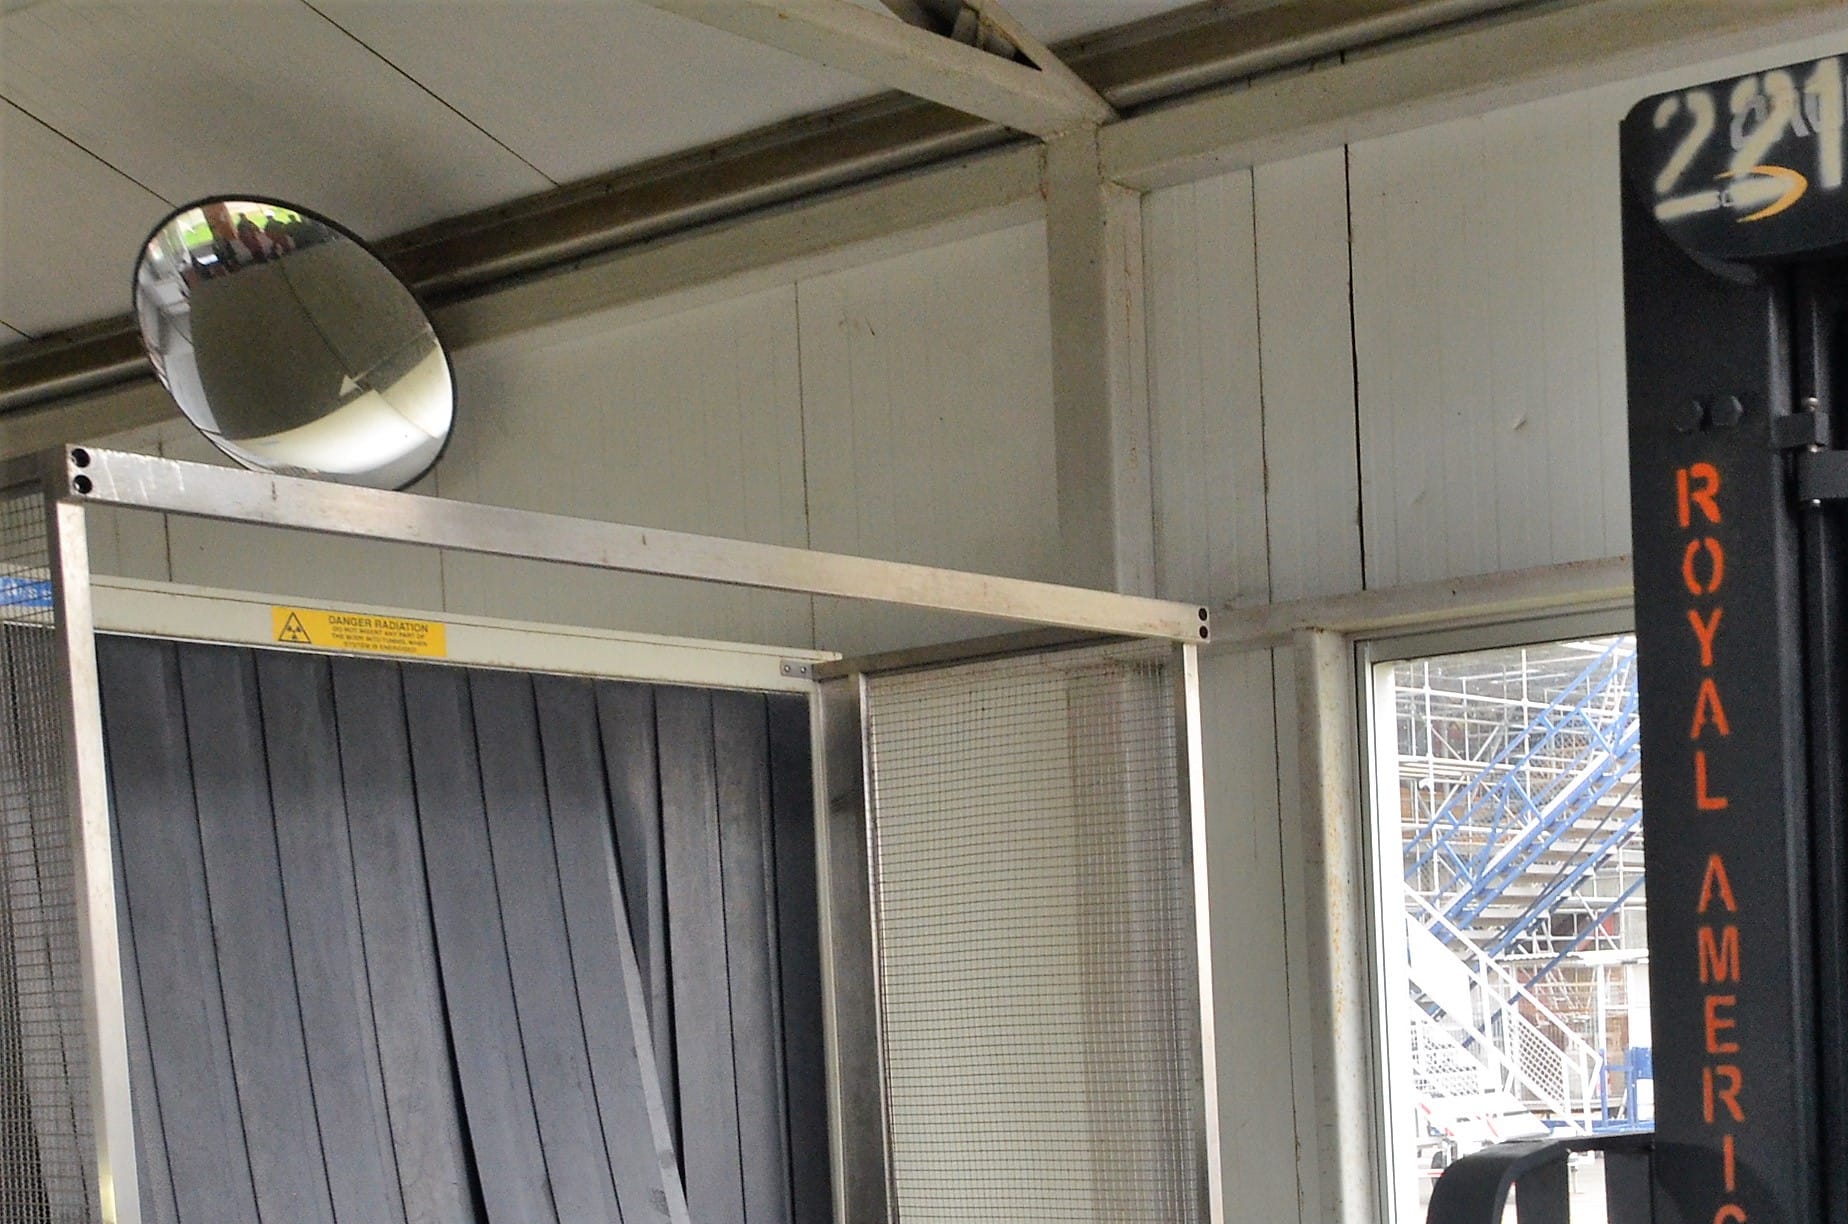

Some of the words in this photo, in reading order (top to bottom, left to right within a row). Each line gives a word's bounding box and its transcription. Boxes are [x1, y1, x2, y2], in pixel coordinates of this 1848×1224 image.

[328, 614, 372, 628] DANGER
[374, 619, 429, 633] RADIATION
[1676, 462, 1730, 811] ROYAL
